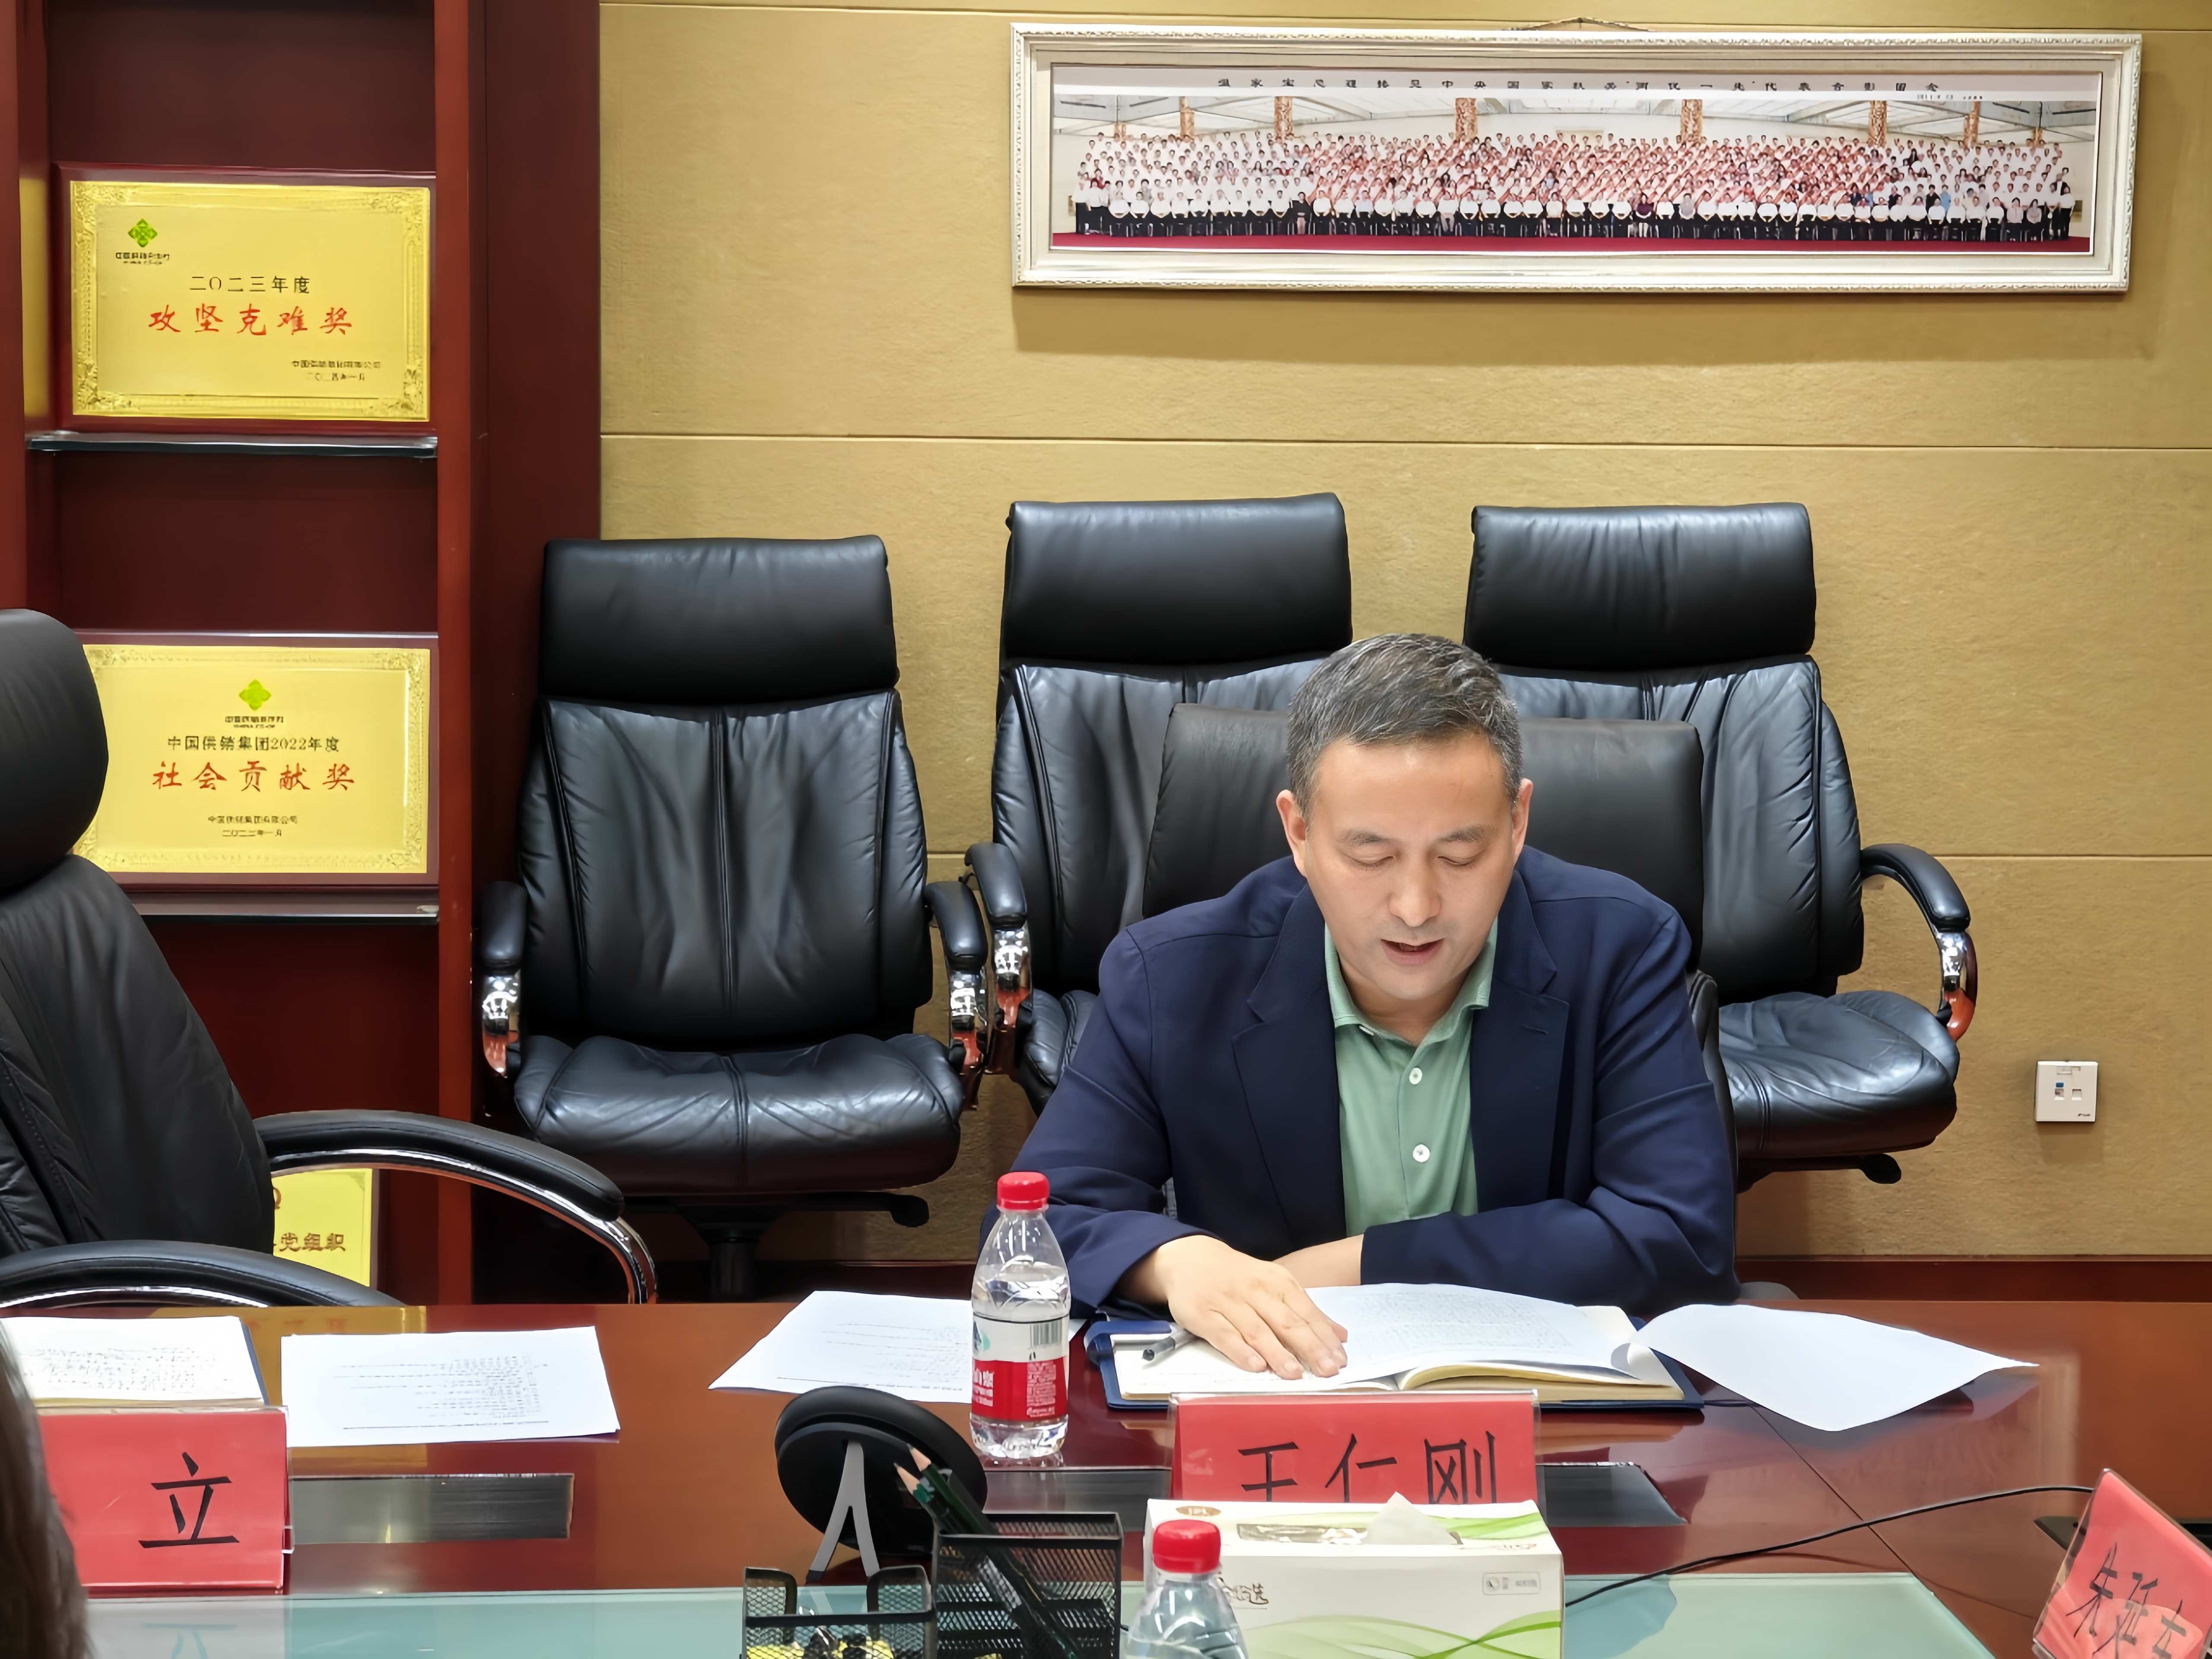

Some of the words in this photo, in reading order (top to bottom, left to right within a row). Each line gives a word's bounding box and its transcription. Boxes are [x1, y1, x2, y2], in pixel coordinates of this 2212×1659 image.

[148, 304, 352, 336] 攻坚克难奖
[168, 736, 340, 752] 中国供销集团2022年度
[152, 761, 354, 792] 社会贡献奖
[279, 1233, 346, 1252] 党组织
[1238, 1431, 1496, 1504] 王仁刚
[138, 1452, 240, 1548] 立
